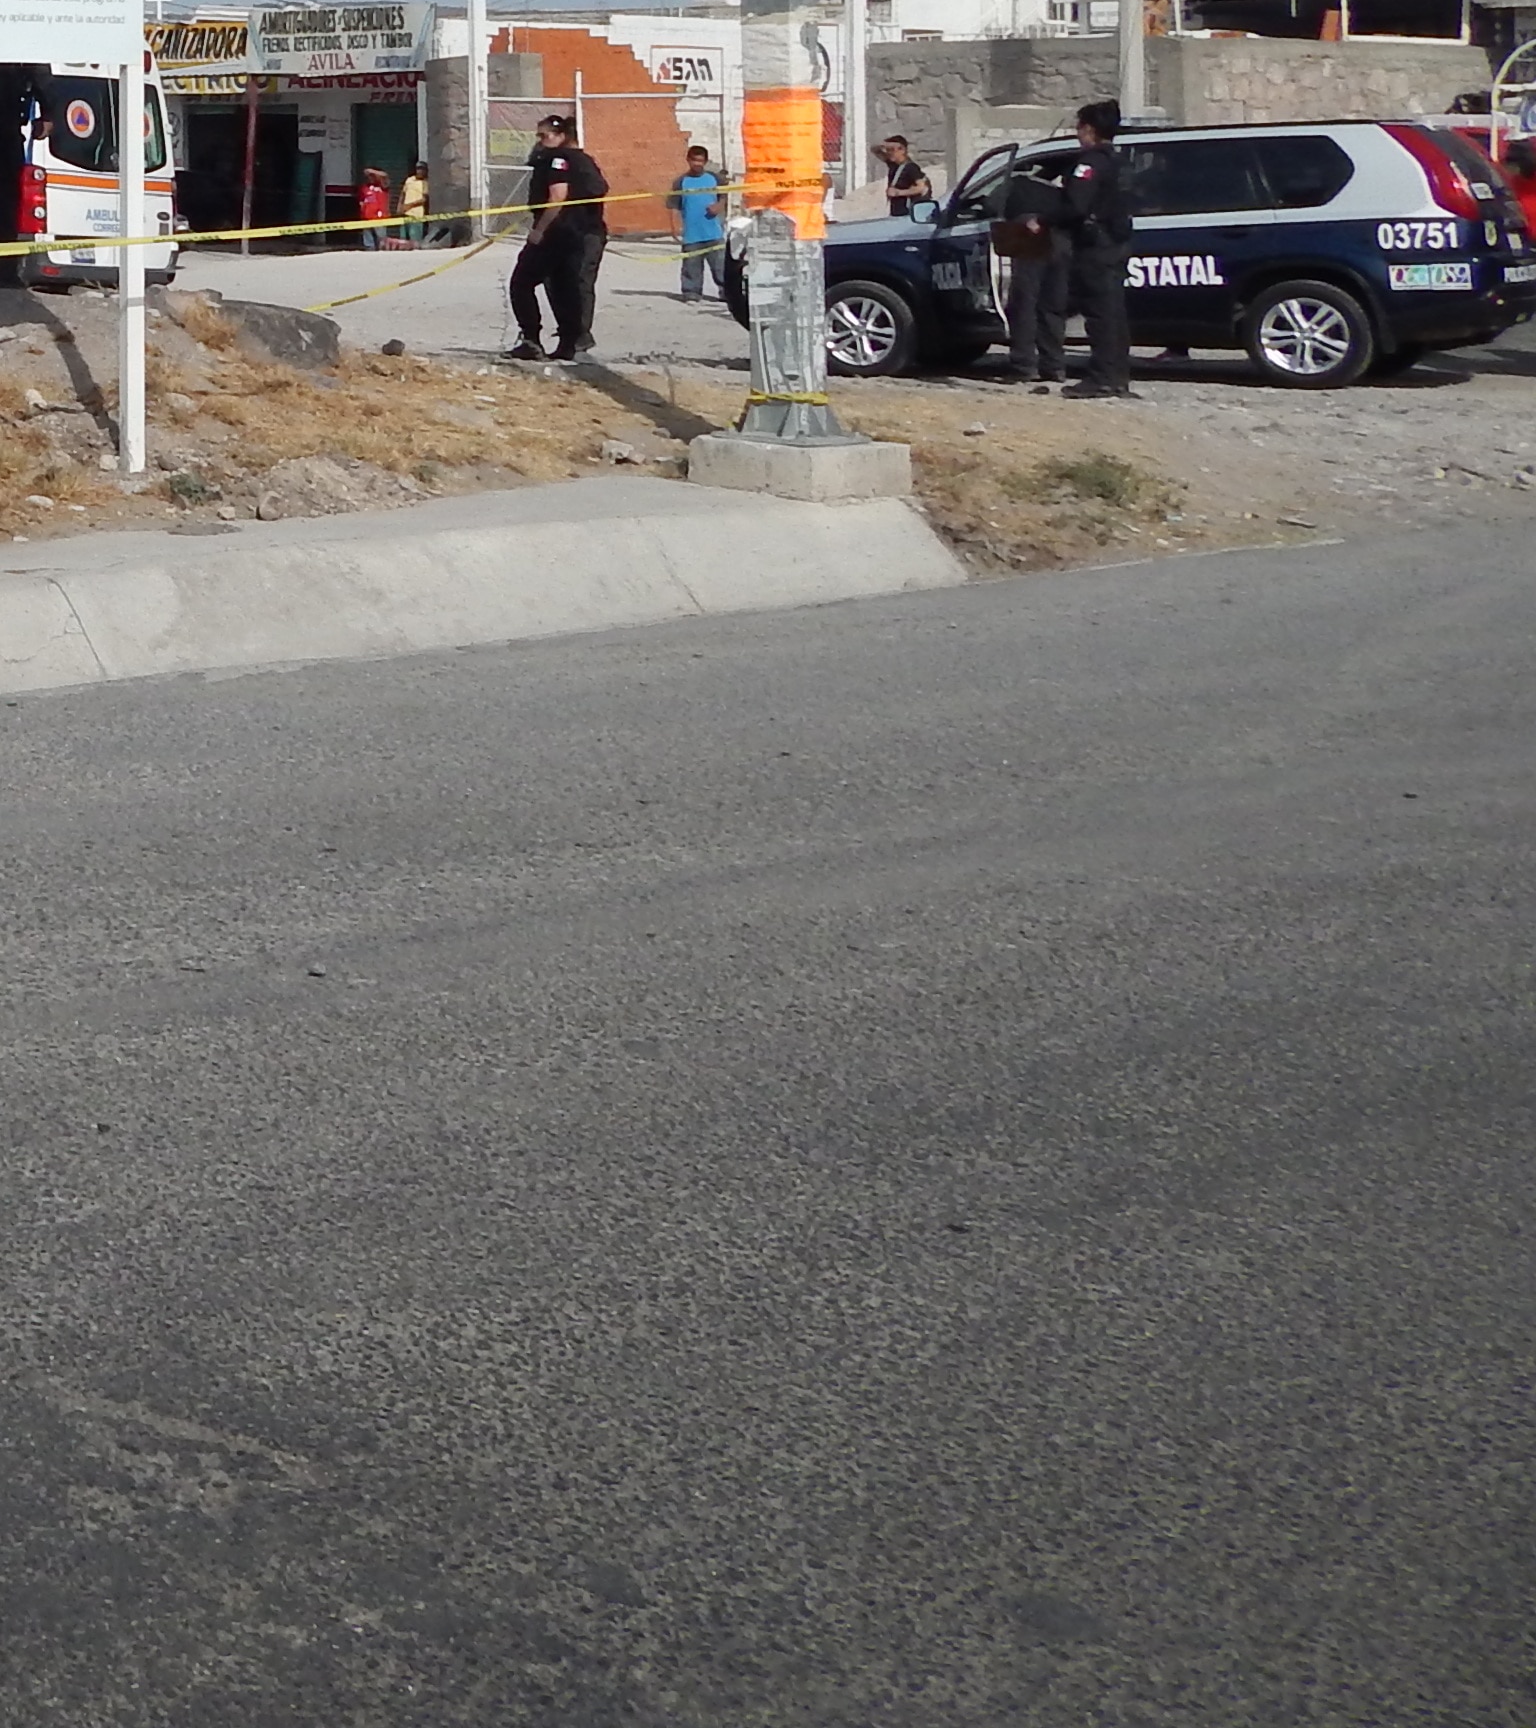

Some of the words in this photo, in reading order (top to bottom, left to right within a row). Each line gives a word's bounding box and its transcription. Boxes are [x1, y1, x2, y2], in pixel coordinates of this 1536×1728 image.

[308, 53, 355, 70] AVILA
[1377, 222, 1459, 250] 03751
[1125, 256, 1224, 288] STATAL
